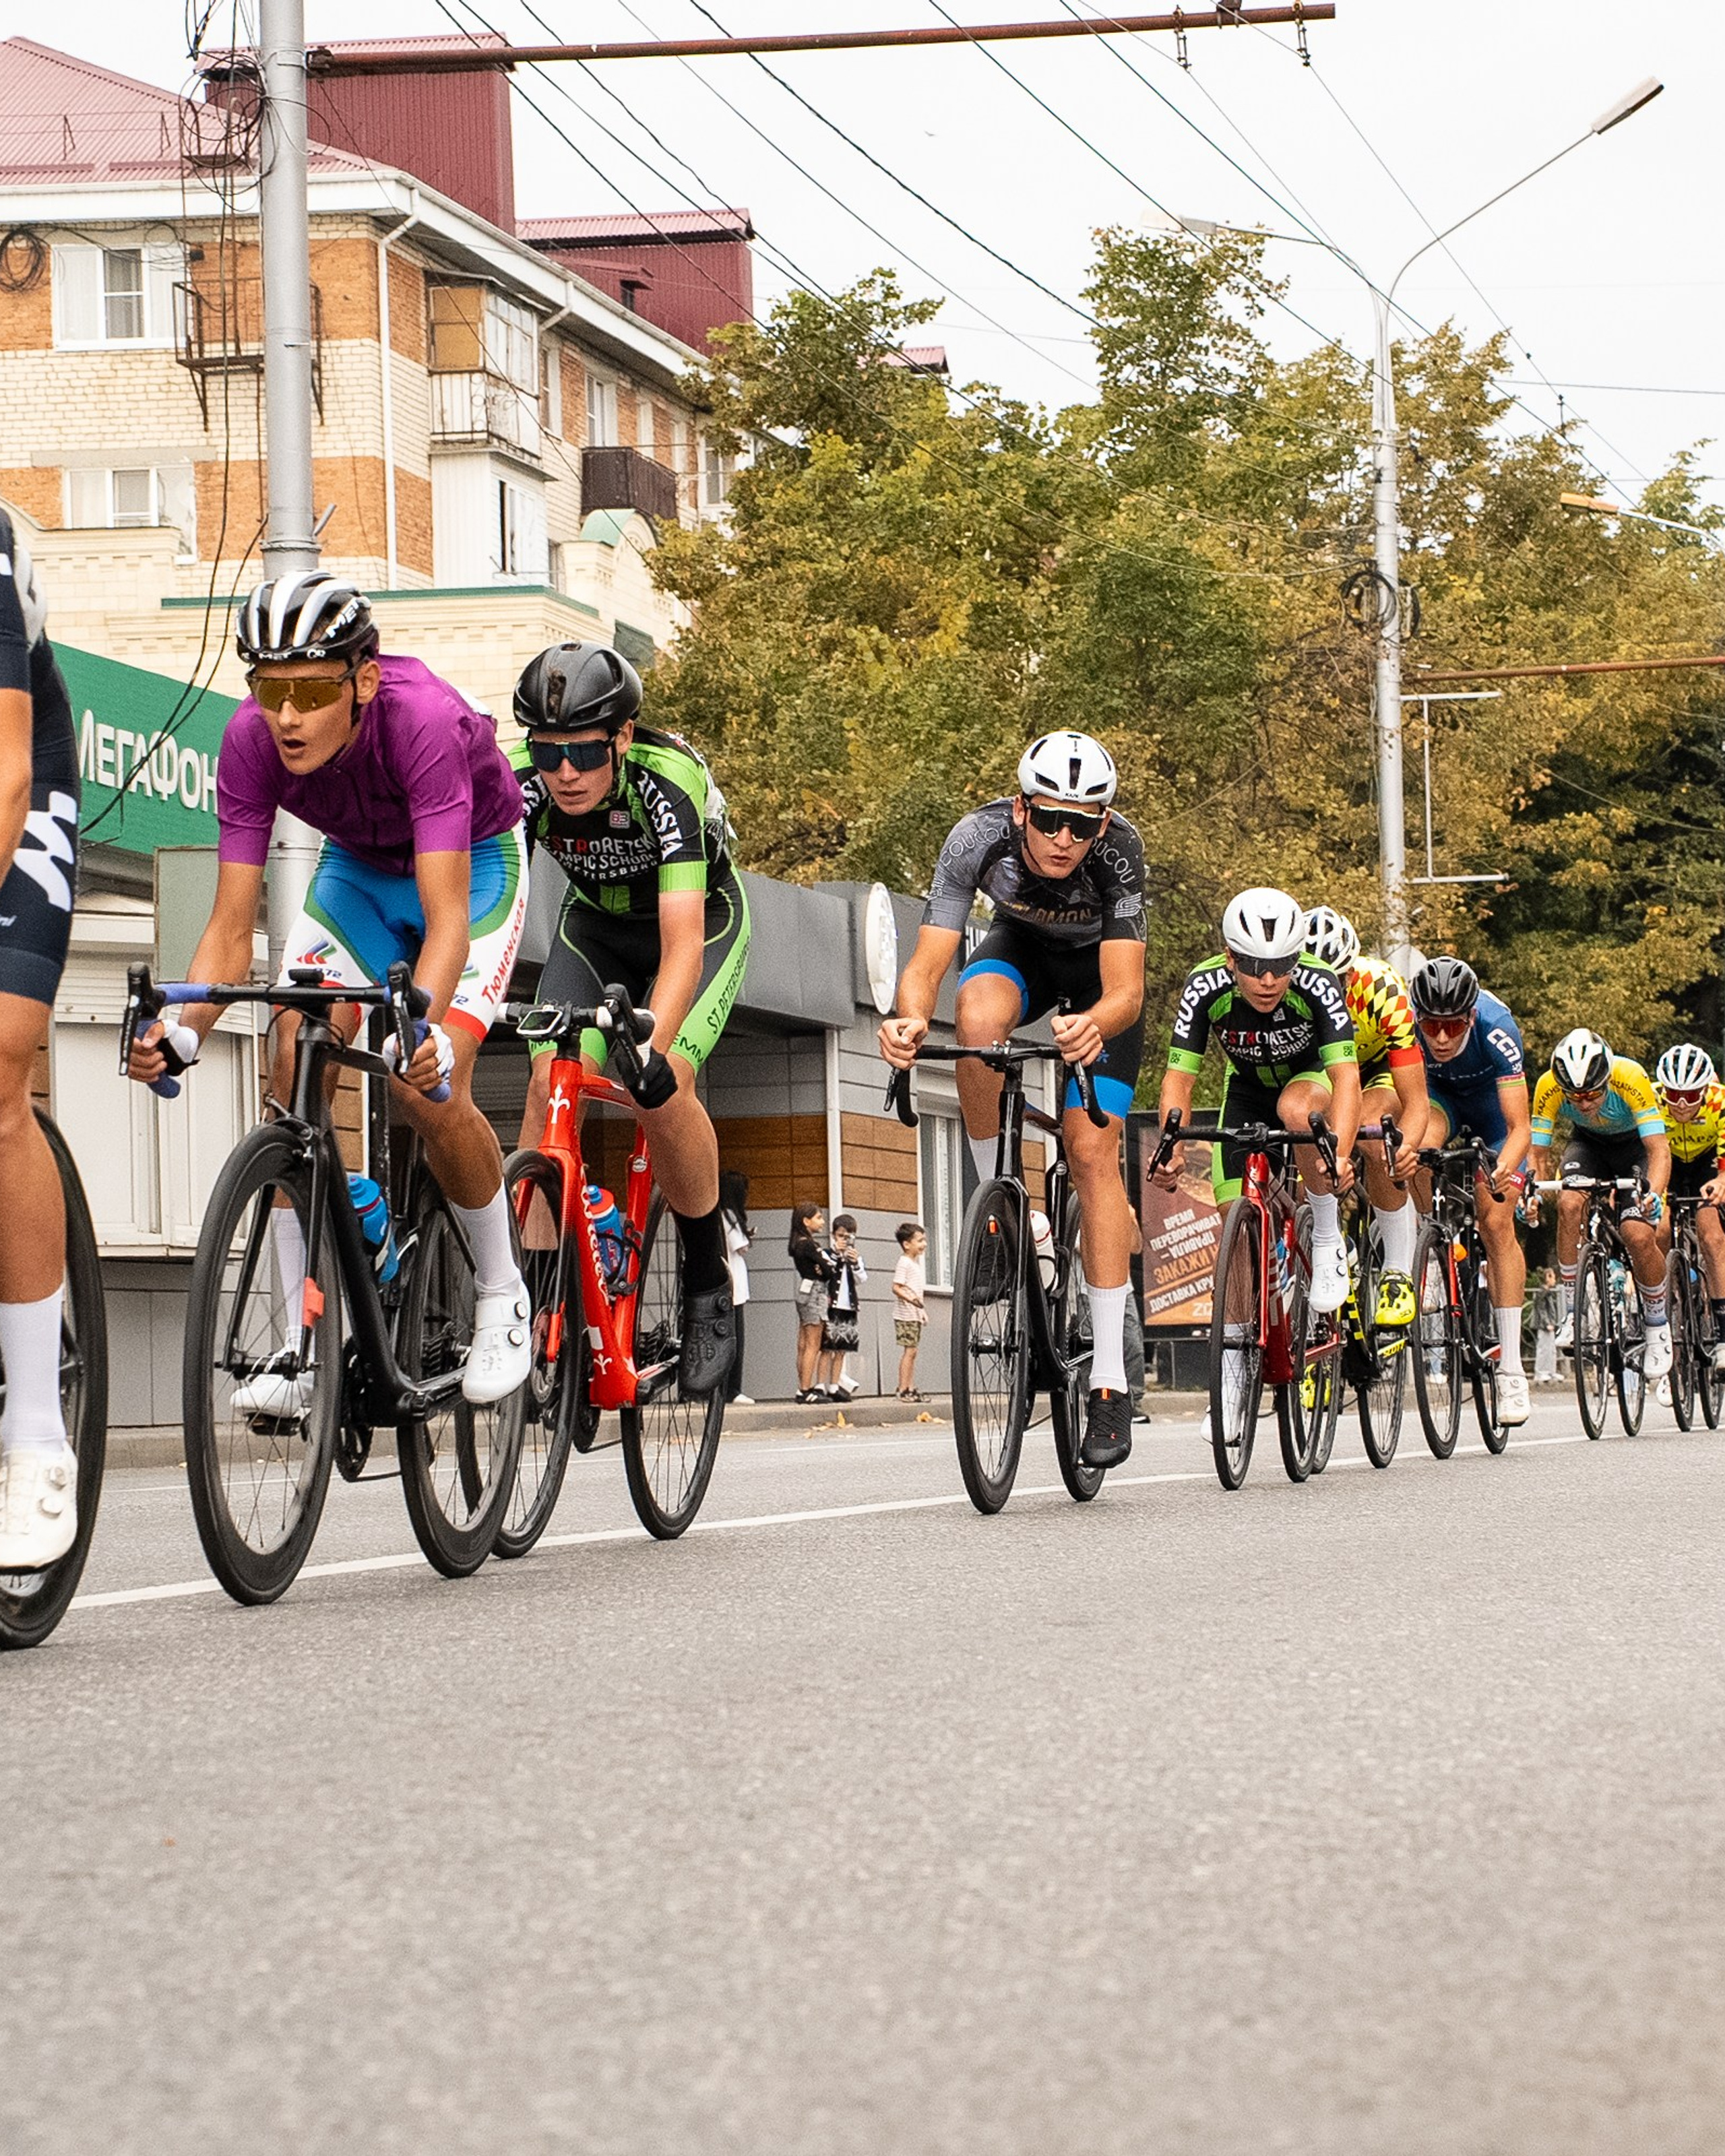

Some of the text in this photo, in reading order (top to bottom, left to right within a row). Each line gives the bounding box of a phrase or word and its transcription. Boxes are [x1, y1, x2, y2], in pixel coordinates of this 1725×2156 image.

[541, 833, 658, 856] ESTRORETSK
[551, 850, 596, 870] MPIC
[939, 825, 1010, 866] COUCOU
[1092, 837, 1135, 883] UCOU
[1174, 968, 1232, 1039] RUSSIA
[1290, 968, 1350, 1031] RUSSIA
[1486, 1027, 1522, 1063] CCN
[1538, 1084, 1561, 1116] KAZAKHS
[1610, 1079, 1647, 1108] AZAKHSTAN
[1150, 1212, 1221, 1251] ПЕРЕВОРАЧИВАТ
[1163, 1208, 1195, 1230] ВРЕМЯ
[1154, 1248, 1210, 1284] ЗАКАЖИ
[1149, 1283, 1197, 1313] ДОСТАВКА
[1195, 1274, 1214, 1293] КРУ
